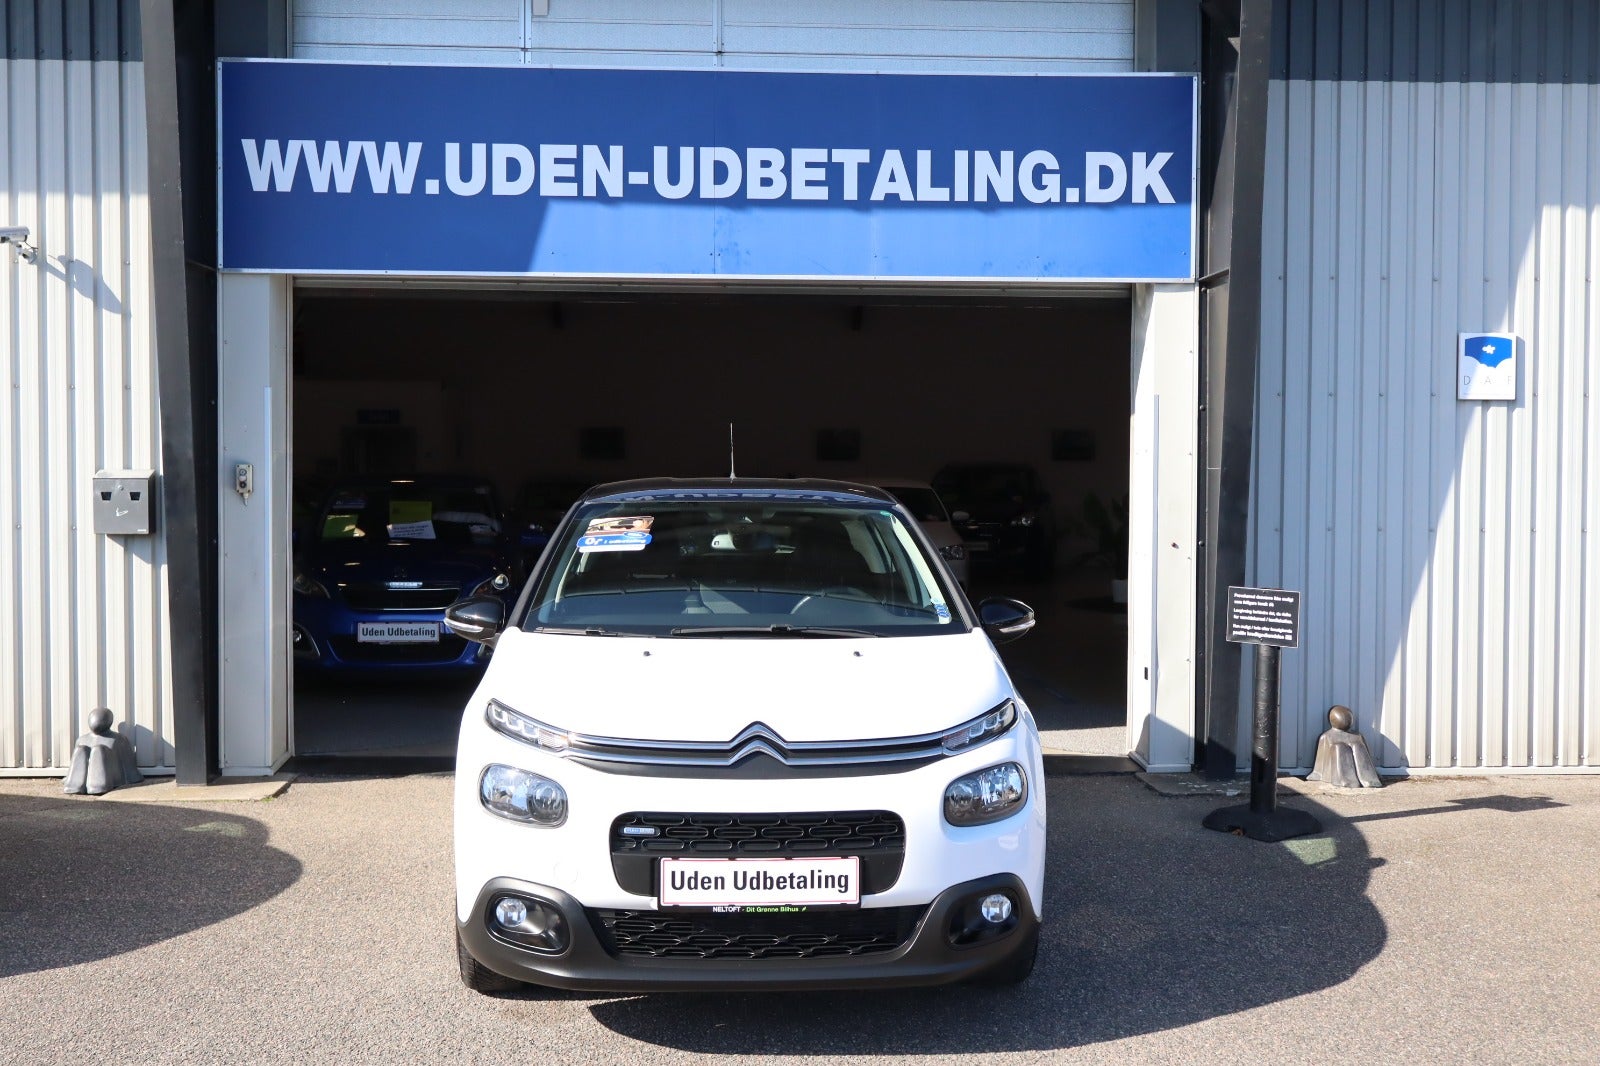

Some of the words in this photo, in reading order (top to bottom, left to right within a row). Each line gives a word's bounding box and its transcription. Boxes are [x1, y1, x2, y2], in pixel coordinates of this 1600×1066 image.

[241, 138, 1177, 205] WWW.UDEN-UDBETALING.DK
[361, 627, 385, 637] Uden
[387, 627, 436, 638] Udbetaling
[671, 870, 725, 891] Uden
[733, 869, 849, 894] Udbetaling
